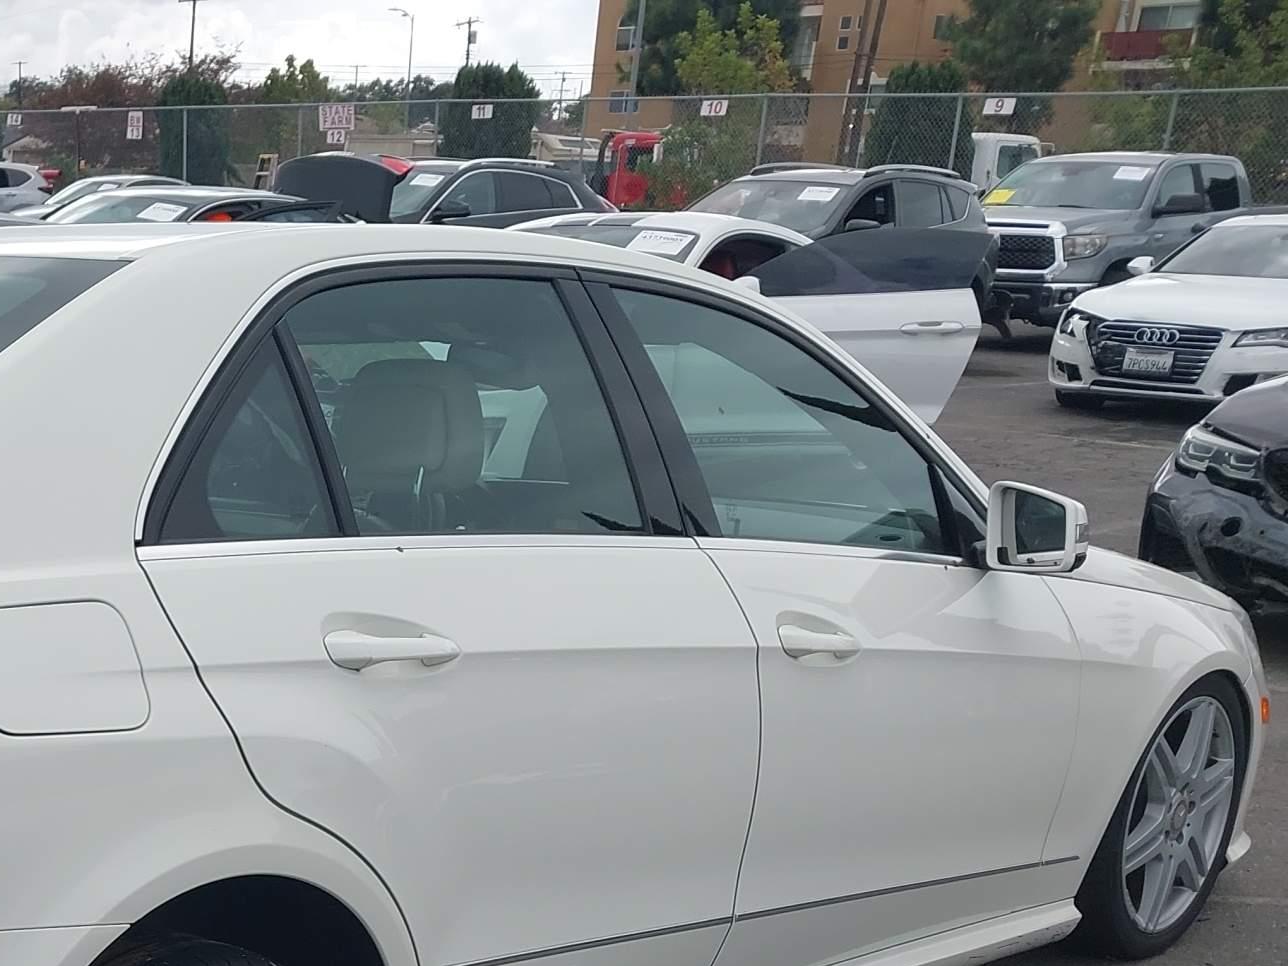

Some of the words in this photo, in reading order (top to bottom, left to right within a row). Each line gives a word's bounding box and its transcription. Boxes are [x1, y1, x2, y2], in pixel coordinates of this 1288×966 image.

[321, 105, 353, 116] STATE
[476, 105, 486, 118] 11
[707, 101, 723, 114] 10
[994, 98, 1005, 113] 9
[323, 116, 352, 126] FARM
[330, 131, 343, 143] 12
